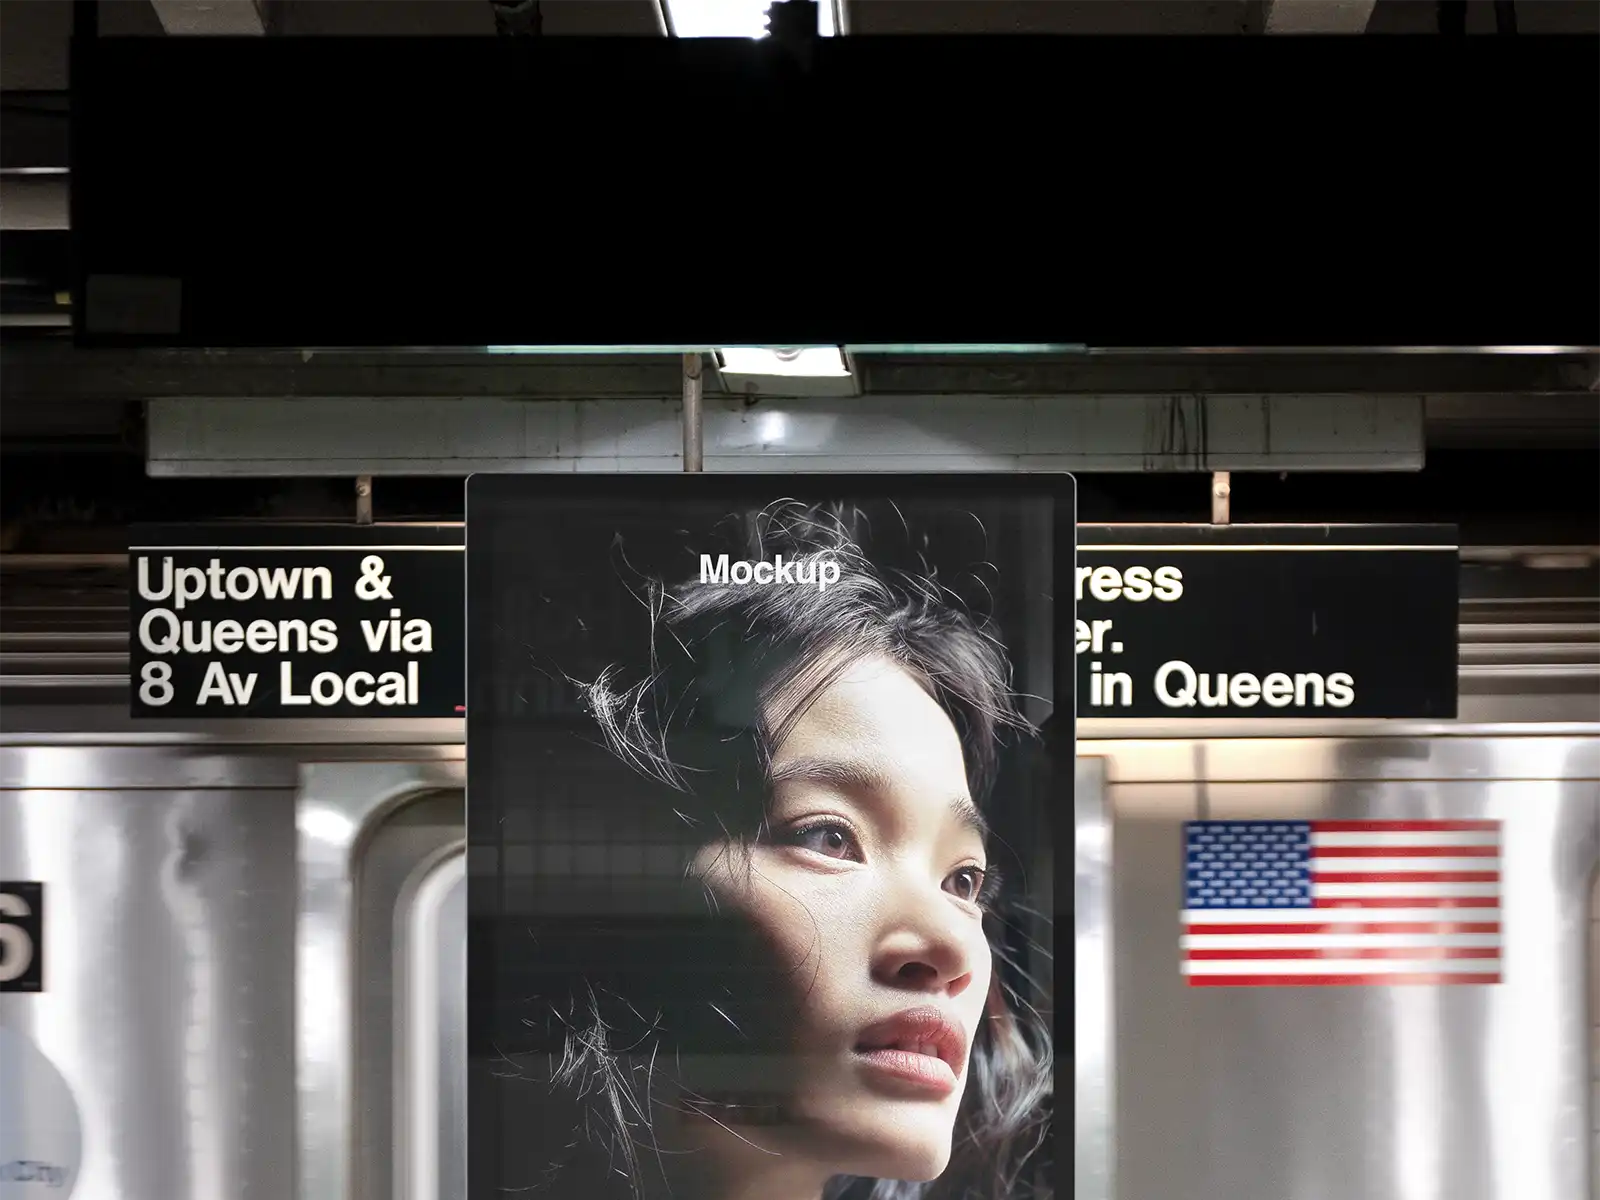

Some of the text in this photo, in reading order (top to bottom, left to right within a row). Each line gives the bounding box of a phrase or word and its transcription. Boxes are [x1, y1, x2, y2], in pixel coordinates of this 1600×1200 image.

[137, 554, 394, 609] Uptown &
[700, 553, 841, 592] Mockup
[138, 607, 433, 655] Queens via
[139, 660, 419, 706] 8 Av Local
[1090, 660, 1355, 708] in Queens
